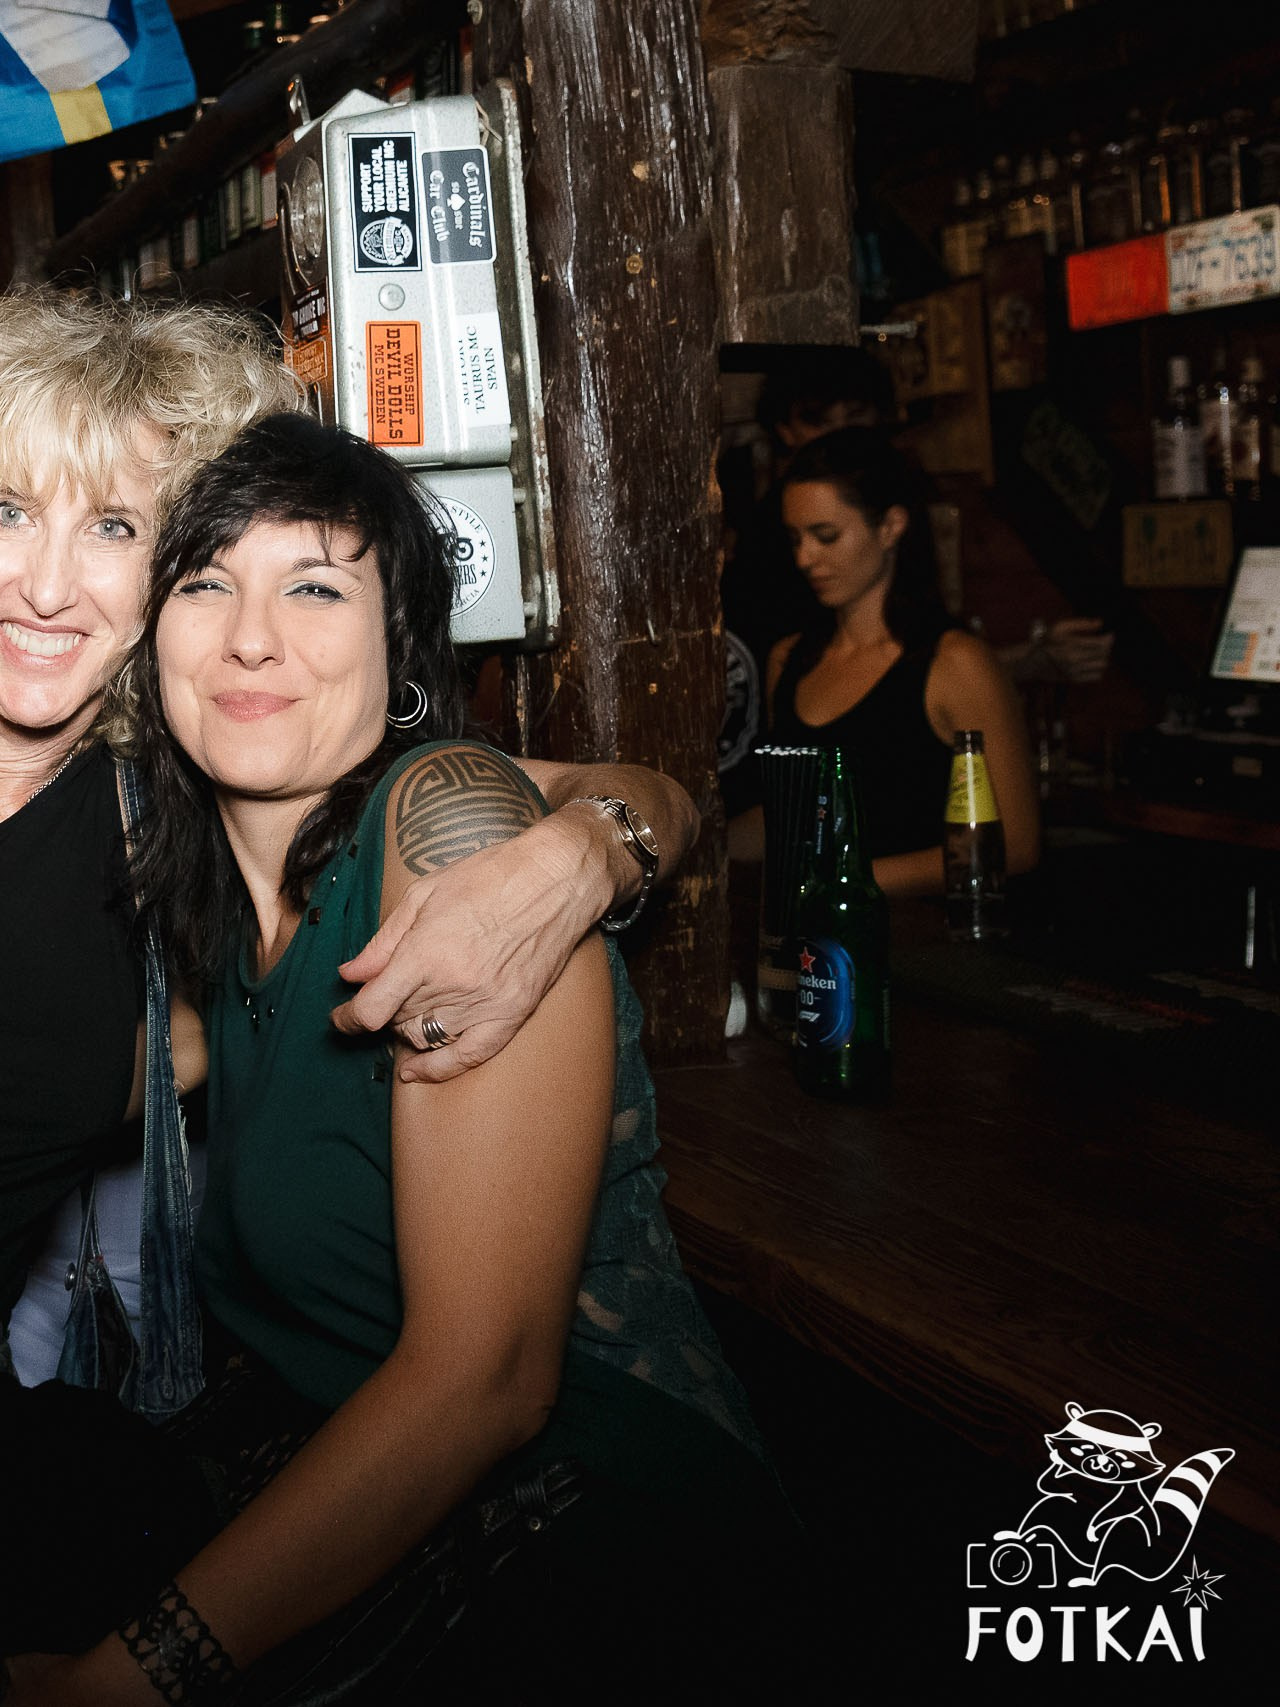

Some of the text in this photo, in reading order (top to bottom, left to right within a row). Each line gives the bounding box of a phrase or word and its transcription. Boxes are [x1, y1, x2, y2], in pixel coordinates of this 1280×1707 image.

[360, 162, 373, 213] SUPPORT
[371, 145, 386, 212] YOUR LOCAL
[383, 140, 398, 213] GREMIUM MC
[396, 159, 410, 212] ALICANTE
[429, 169, 450, 242] Car Club
[462, 161, 487, 248] Cardinals
[374, 344, 386, 424] MC SWEDEN
[386, 328, 403, 440] DEVIL DOLLS
[403, 352, 415, 416] WORSHIP
[466, 325, 485, 414] TAURUS MC
[483, 346, 498, 390] SPAIN
